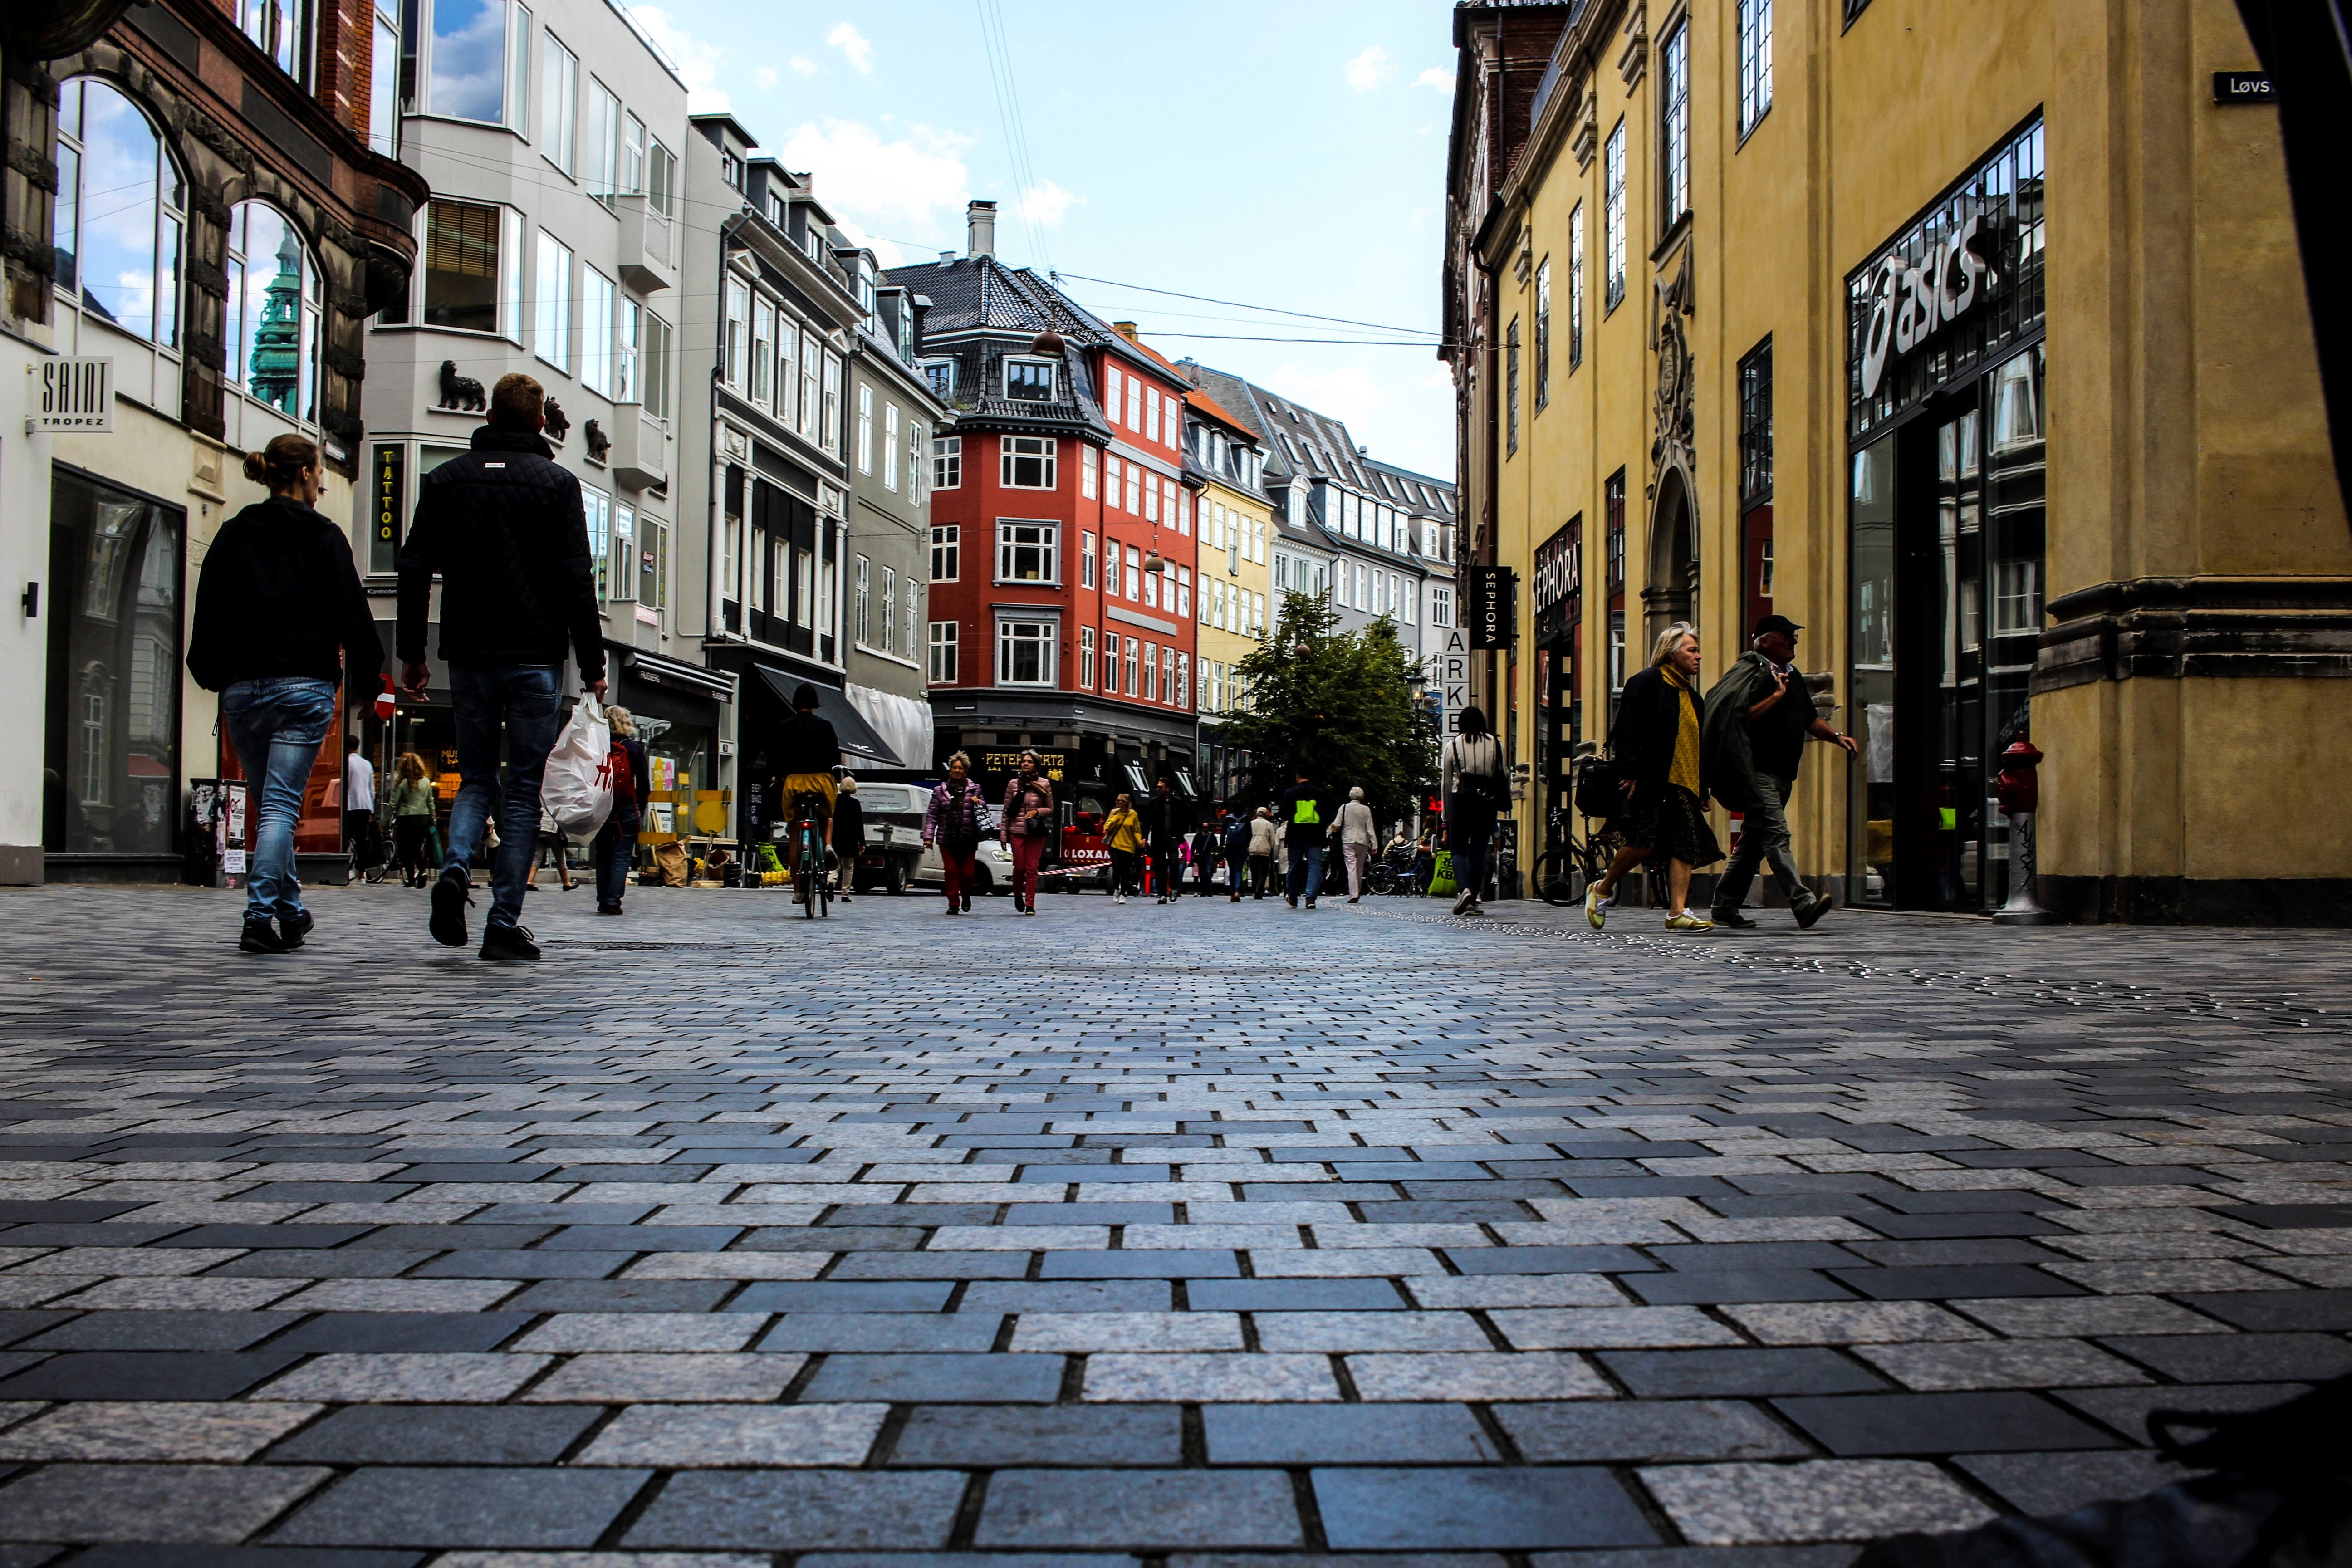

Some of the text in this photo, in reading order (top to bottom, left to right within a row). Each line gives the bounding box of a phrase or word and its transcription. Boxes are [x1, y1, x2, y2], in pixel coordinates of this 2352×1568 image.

[2230, 78, 2270, 93] Løvs
[43, 362, 108, 413] SAINT
[382, 451, 394, 539] TATTOO
[1485, 573, 1495, 643] SEPHORA
[1532, 549, 1578, 617] SEPHORA
[1447, 632, 1464, 734] ARKE
[594, 749, 613, 795] H&
[1436, 868, 1456, 881] KB
